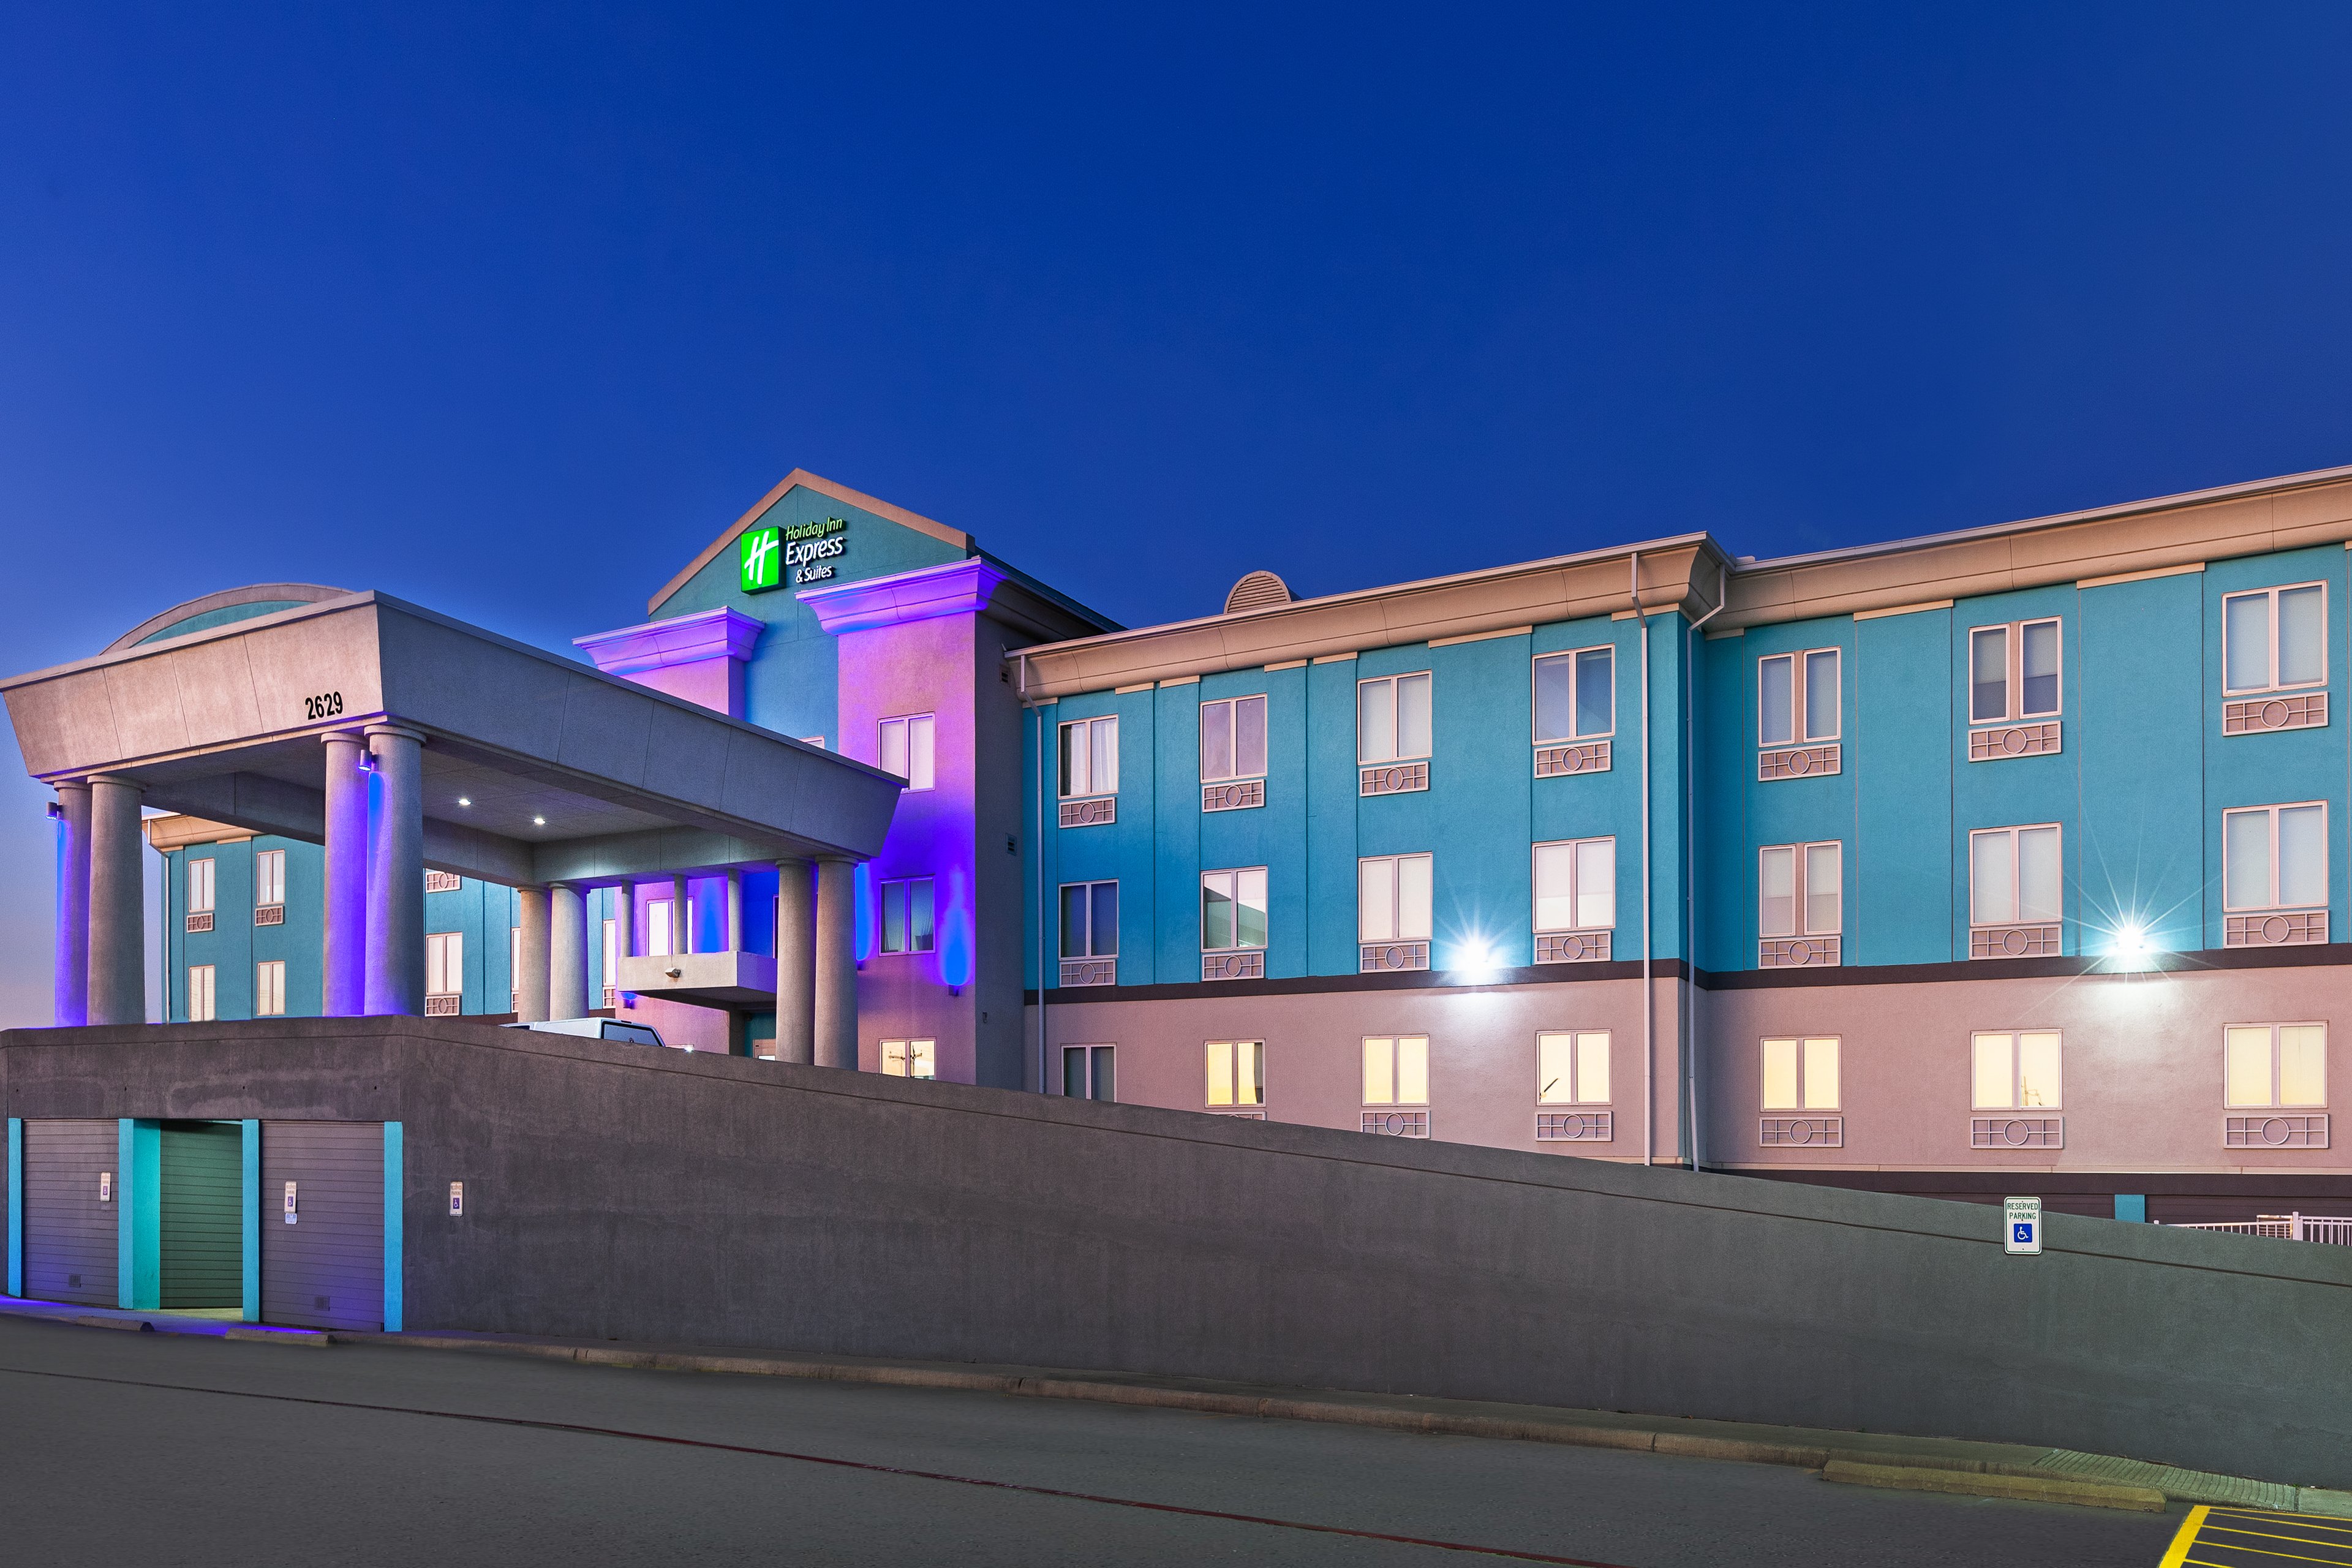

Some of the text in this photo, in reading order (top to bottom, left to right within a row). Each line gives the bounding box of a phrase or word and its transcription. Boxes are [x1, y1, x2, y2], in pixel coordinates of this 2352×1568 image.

[786, 517, 842, 541] Holiday Inn
[744, 531, 778, 584] H
[786, 537, 843, 567] Express
[796, 565, 832, 583] & Suites
[305, 691, 343, 720] 2629
